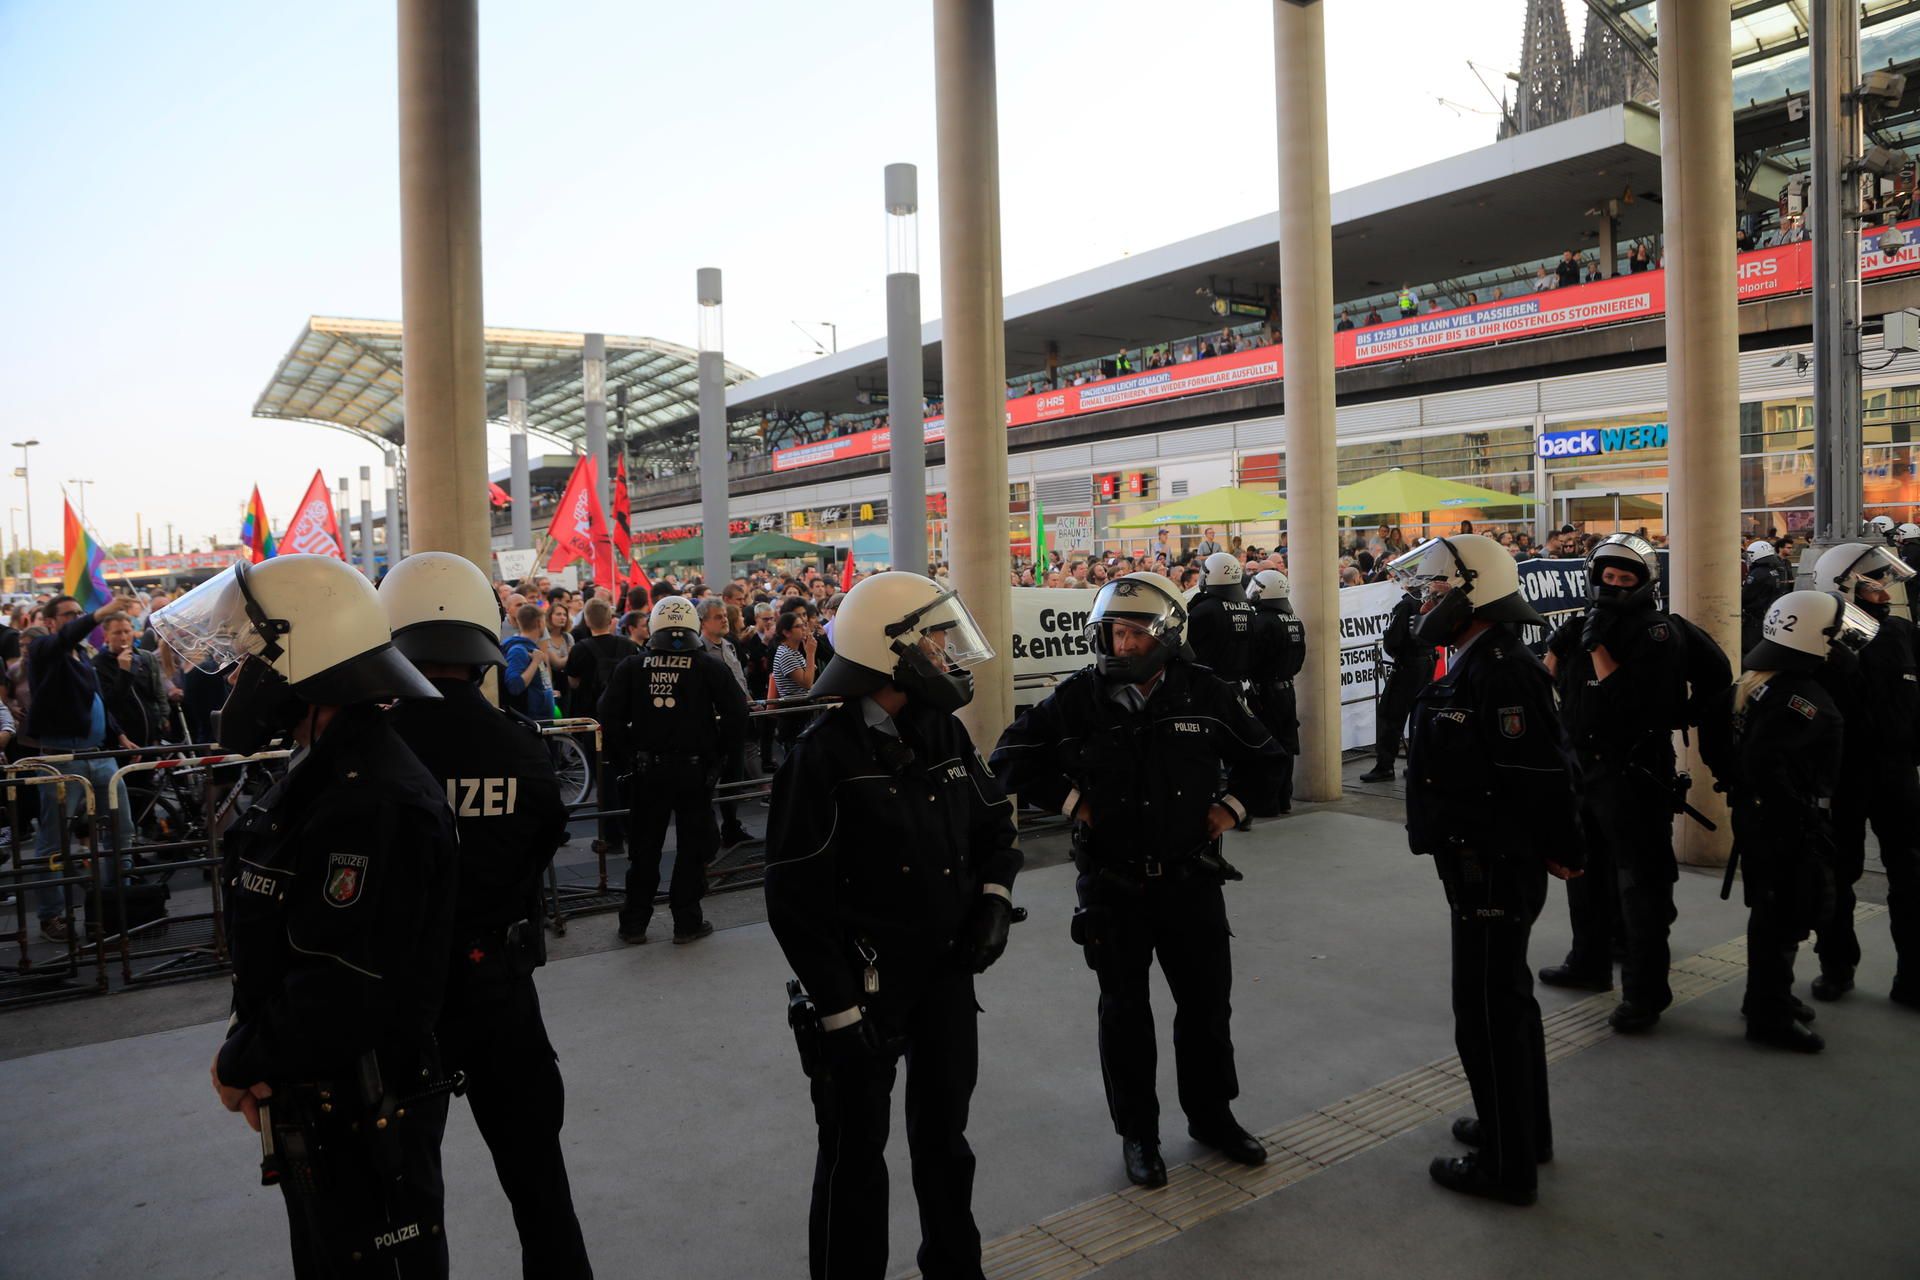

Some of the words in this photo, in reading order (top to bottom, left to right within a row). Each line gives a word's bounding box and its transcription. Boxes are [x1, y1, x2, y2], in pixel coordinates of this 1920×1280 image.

[1357, 334, 1371, 344] BIS
[1374, 330, 1397, 342] 17:59
[1400, 325, 1419, 337] UHR
[1421, 320, 1450, 333] KANN
[1452, 315, 1474, 327] VIEL
[1477, 303, 1538, 320] PASSIEREN:
[1357, 346, 1369, 356] IM
[1371, 338, 1414, 353] BUSINESS
[1417, 334, 1444, 346] TARIF
[1446, 330, 1462, 341] BIS
[1465, 327, 1476, 337] 18
[1479, 323, 1501, 335] UHR
[1502, 311, 1566, 330] KOSTENLOS
[1569, 297, 1648, 319] STORNIEREN.
[1188, 374, 1231, 387] FORMULARE
[1046, 395, 1065, 407] HRS
[1539, 431, 1596, 456] back
[1057, 517, 1075, 528] ACH
[1058, 528, 1080, 538] BRAUN
[1082, 528, 1092, 538] IST
[658, 602, 692, 616] 2-2-2
[667, 613, 684, 621] NRW
[1232, 614, 1248, 623] NRW
[643, 656, 692, 669] POLIZEI
[651, 672, 680, 683] NRW
[648, 684, 673, 695] 1222
[1174, 722, 1201, 733] POLIZEI
[331, 855, 367, 868] POLIZEI
[374, 1223, 420, 1250] POLIZEI
